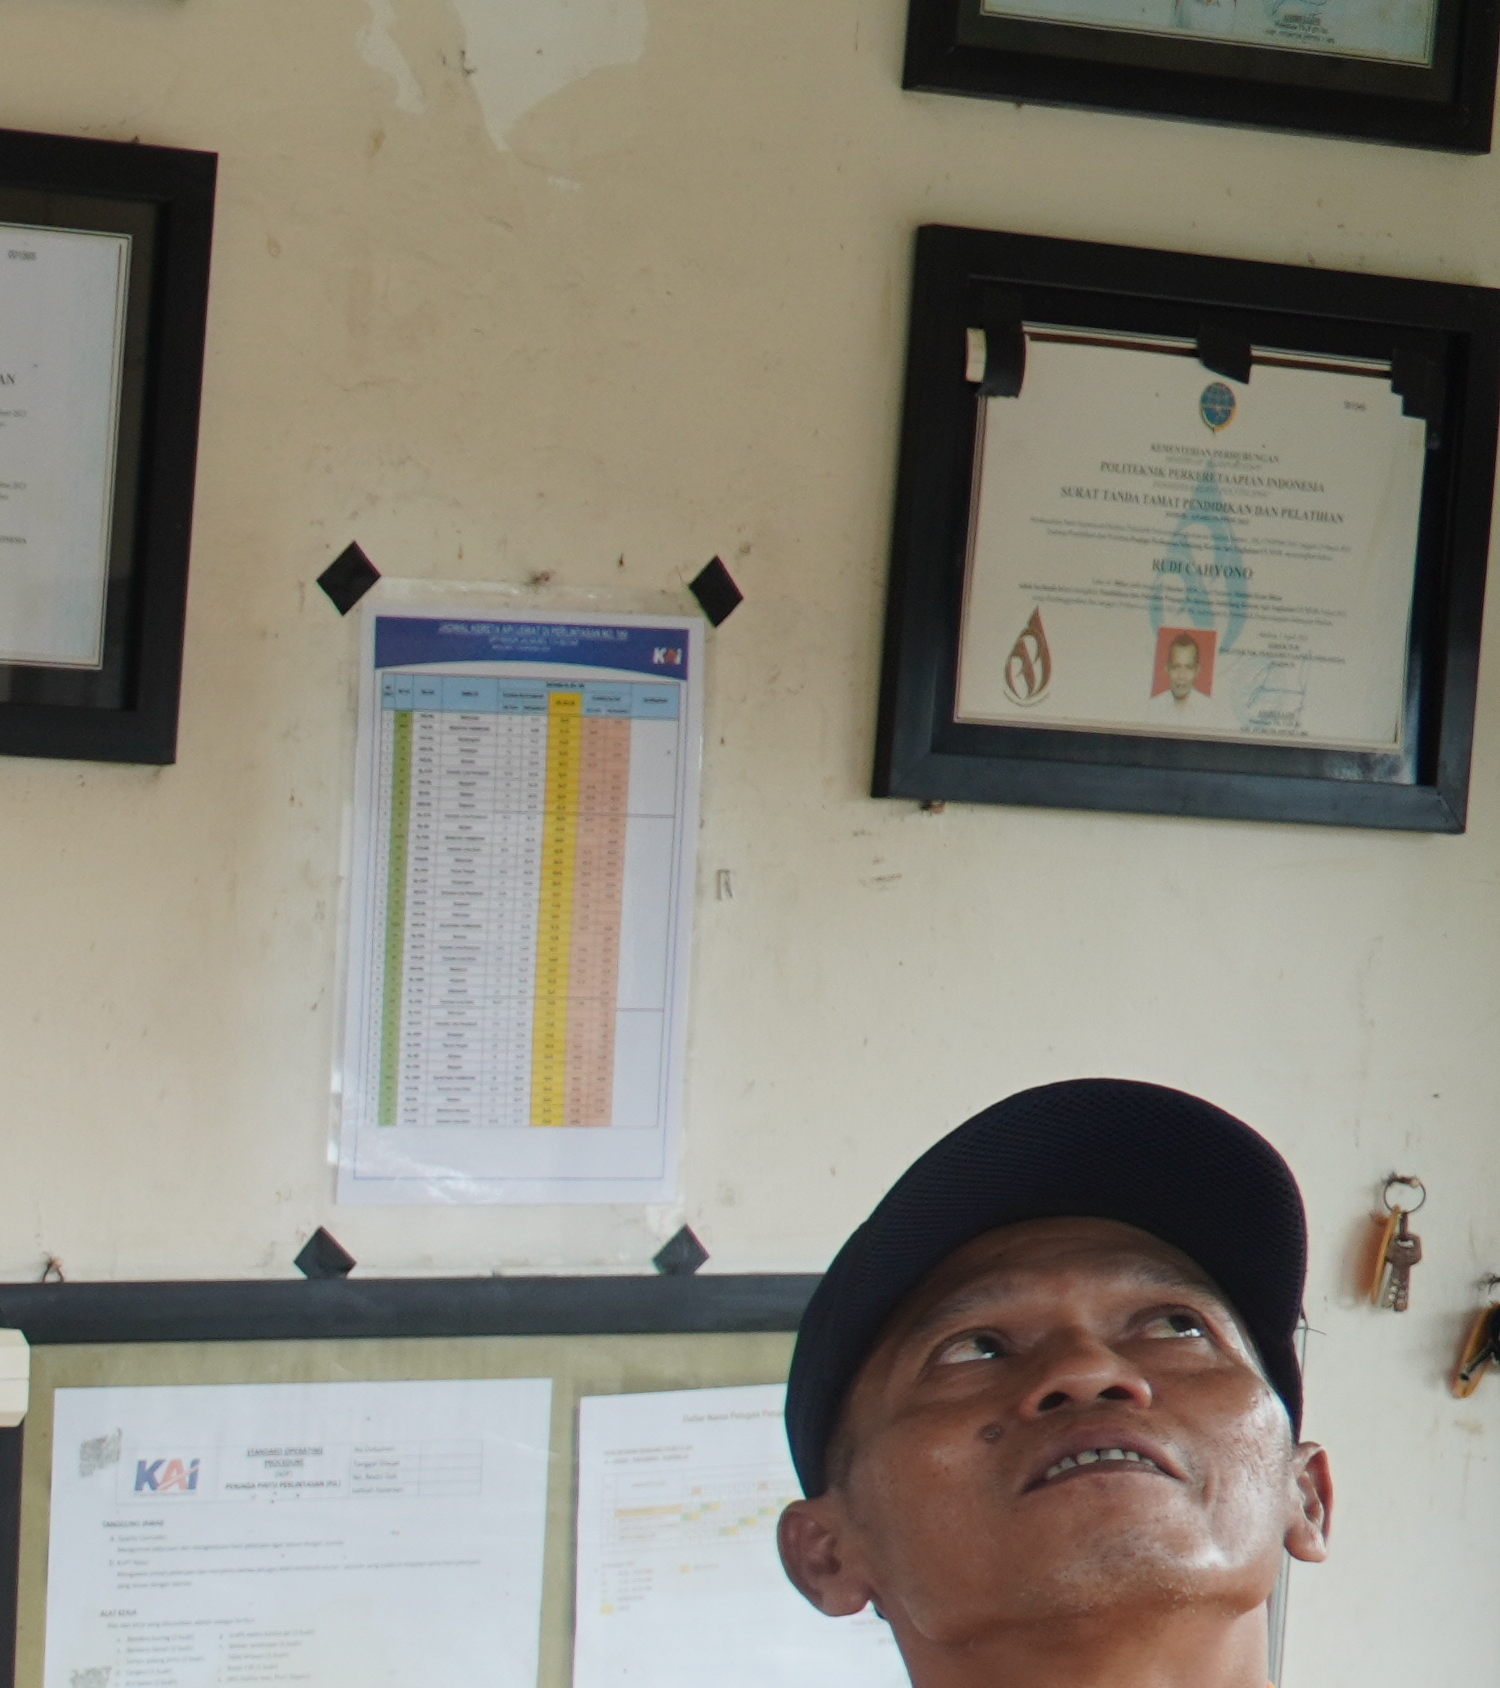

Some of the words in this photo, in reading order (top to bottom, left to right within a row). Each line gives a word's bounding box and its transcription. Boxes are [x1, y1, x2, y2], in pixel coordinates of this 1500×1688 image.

[1100, 460, 1165, 479] POLITEKNIK
[1266, 475, 1326, 493] INDONESIA
[1060, 485, 1101, 501] SURAT
[1103, 488, 1140, 504] TANDA
[1182, 496, 1252, 516] PENDIDIKAN
[1280, 505, 1345, 525] PELATIHAN
[1151, 556, 1184, 575] RUDI
[1184, 561, 1255, 581] CAHYONO
[134, 1457, 200, 1492] KAI
